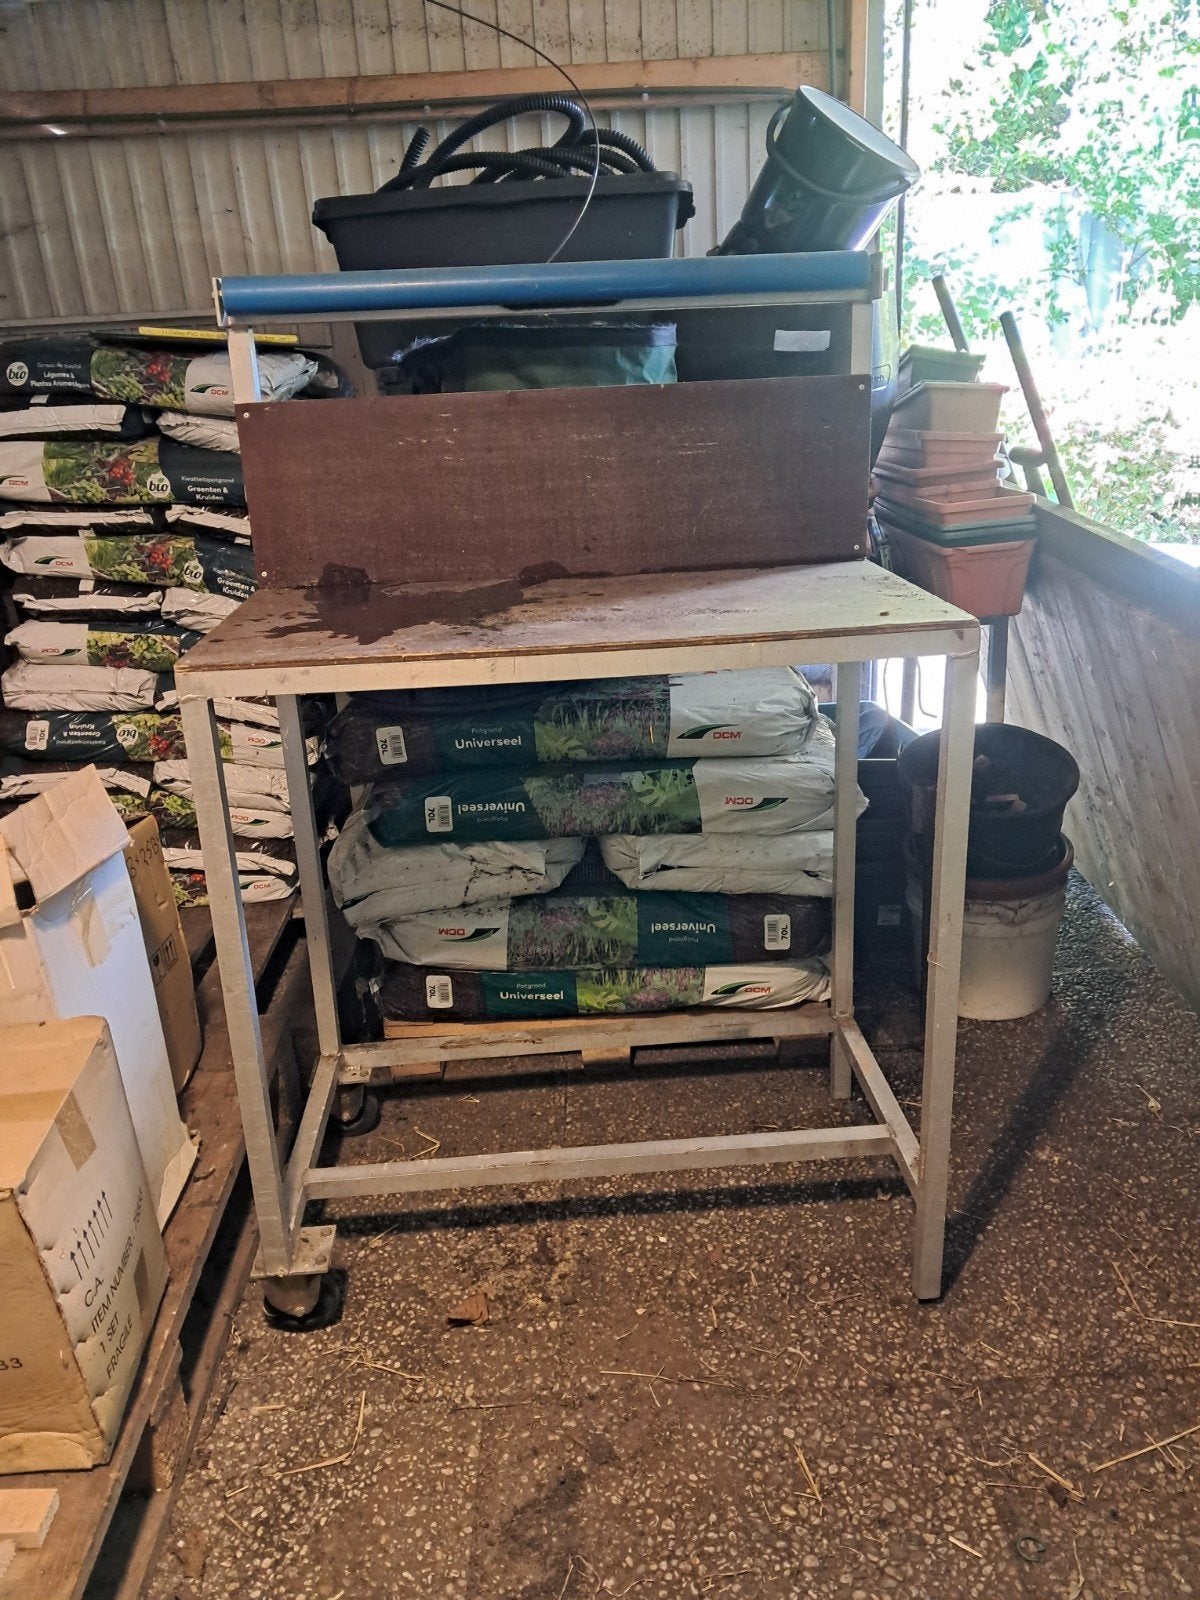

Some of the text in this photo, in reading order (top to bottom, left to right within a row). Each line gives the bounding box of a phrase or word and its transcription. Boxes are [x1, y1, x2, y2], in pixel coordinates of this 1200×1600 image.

[211, 388, 229, 396] DCM
[187, 485, 229, 494] Groenten &
[195, 493, 225, 501] Kruiden
[216, 576, 250, 591] Groenten
[222, 586, 249, 599] Kruiden
[471, 726, 503, 735] Potgrond
[712, 731, 743, 740] DCM
[247, 736, 266, 744] DCM
[454, 735, 522, 749] Universeel
[378, 738, 389, 756] 70L
[724, 796, 754, 805] DCM
[457, 801, 526, 815] Universeel
[427, 807, 436, 824] 70L
[253, 882, 272, 890] DCM
[437, 928, 466, 936] DCM
[651, 922, 717, 934] Universeel
[780, 924, 789, 941] 70L
[428, 985, 437, 999] 70L
[516, 982, 547, 991] Potgrond
[744, 986, 772, 994] DCM
[499, 990, 564, 1001] Universeel
[84, 1276, 104, 1308] C.A.
[91, 1297, 113, 1333] ITEM
[99, 1310, 120, 1354] 1 SET
[106, 1316, 134, 1380] FRAGILE
